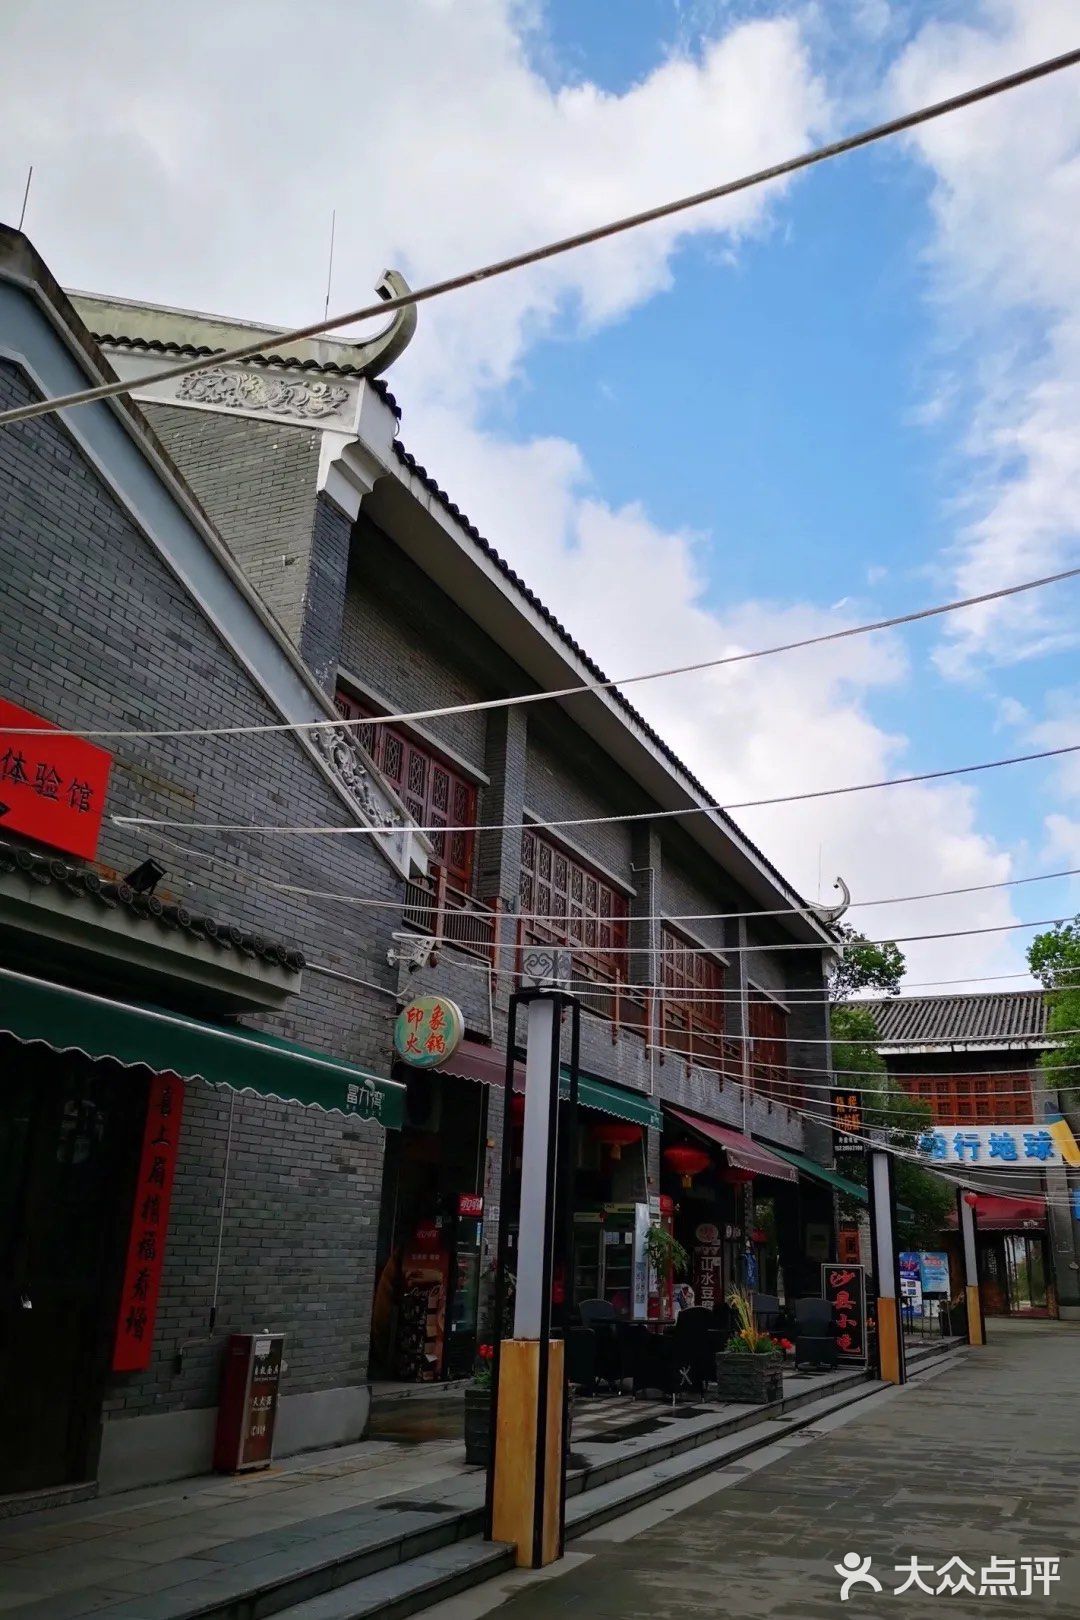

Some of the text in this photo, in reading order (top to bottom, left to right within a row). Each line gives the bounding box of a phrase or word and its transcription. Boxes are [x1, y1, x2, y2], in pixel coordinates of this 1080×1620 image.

[1, 746, 95, 813] 体验馆
[406, 1004, 447, 1031] 印象
[402, 1032, 446, 1055] 火锅
